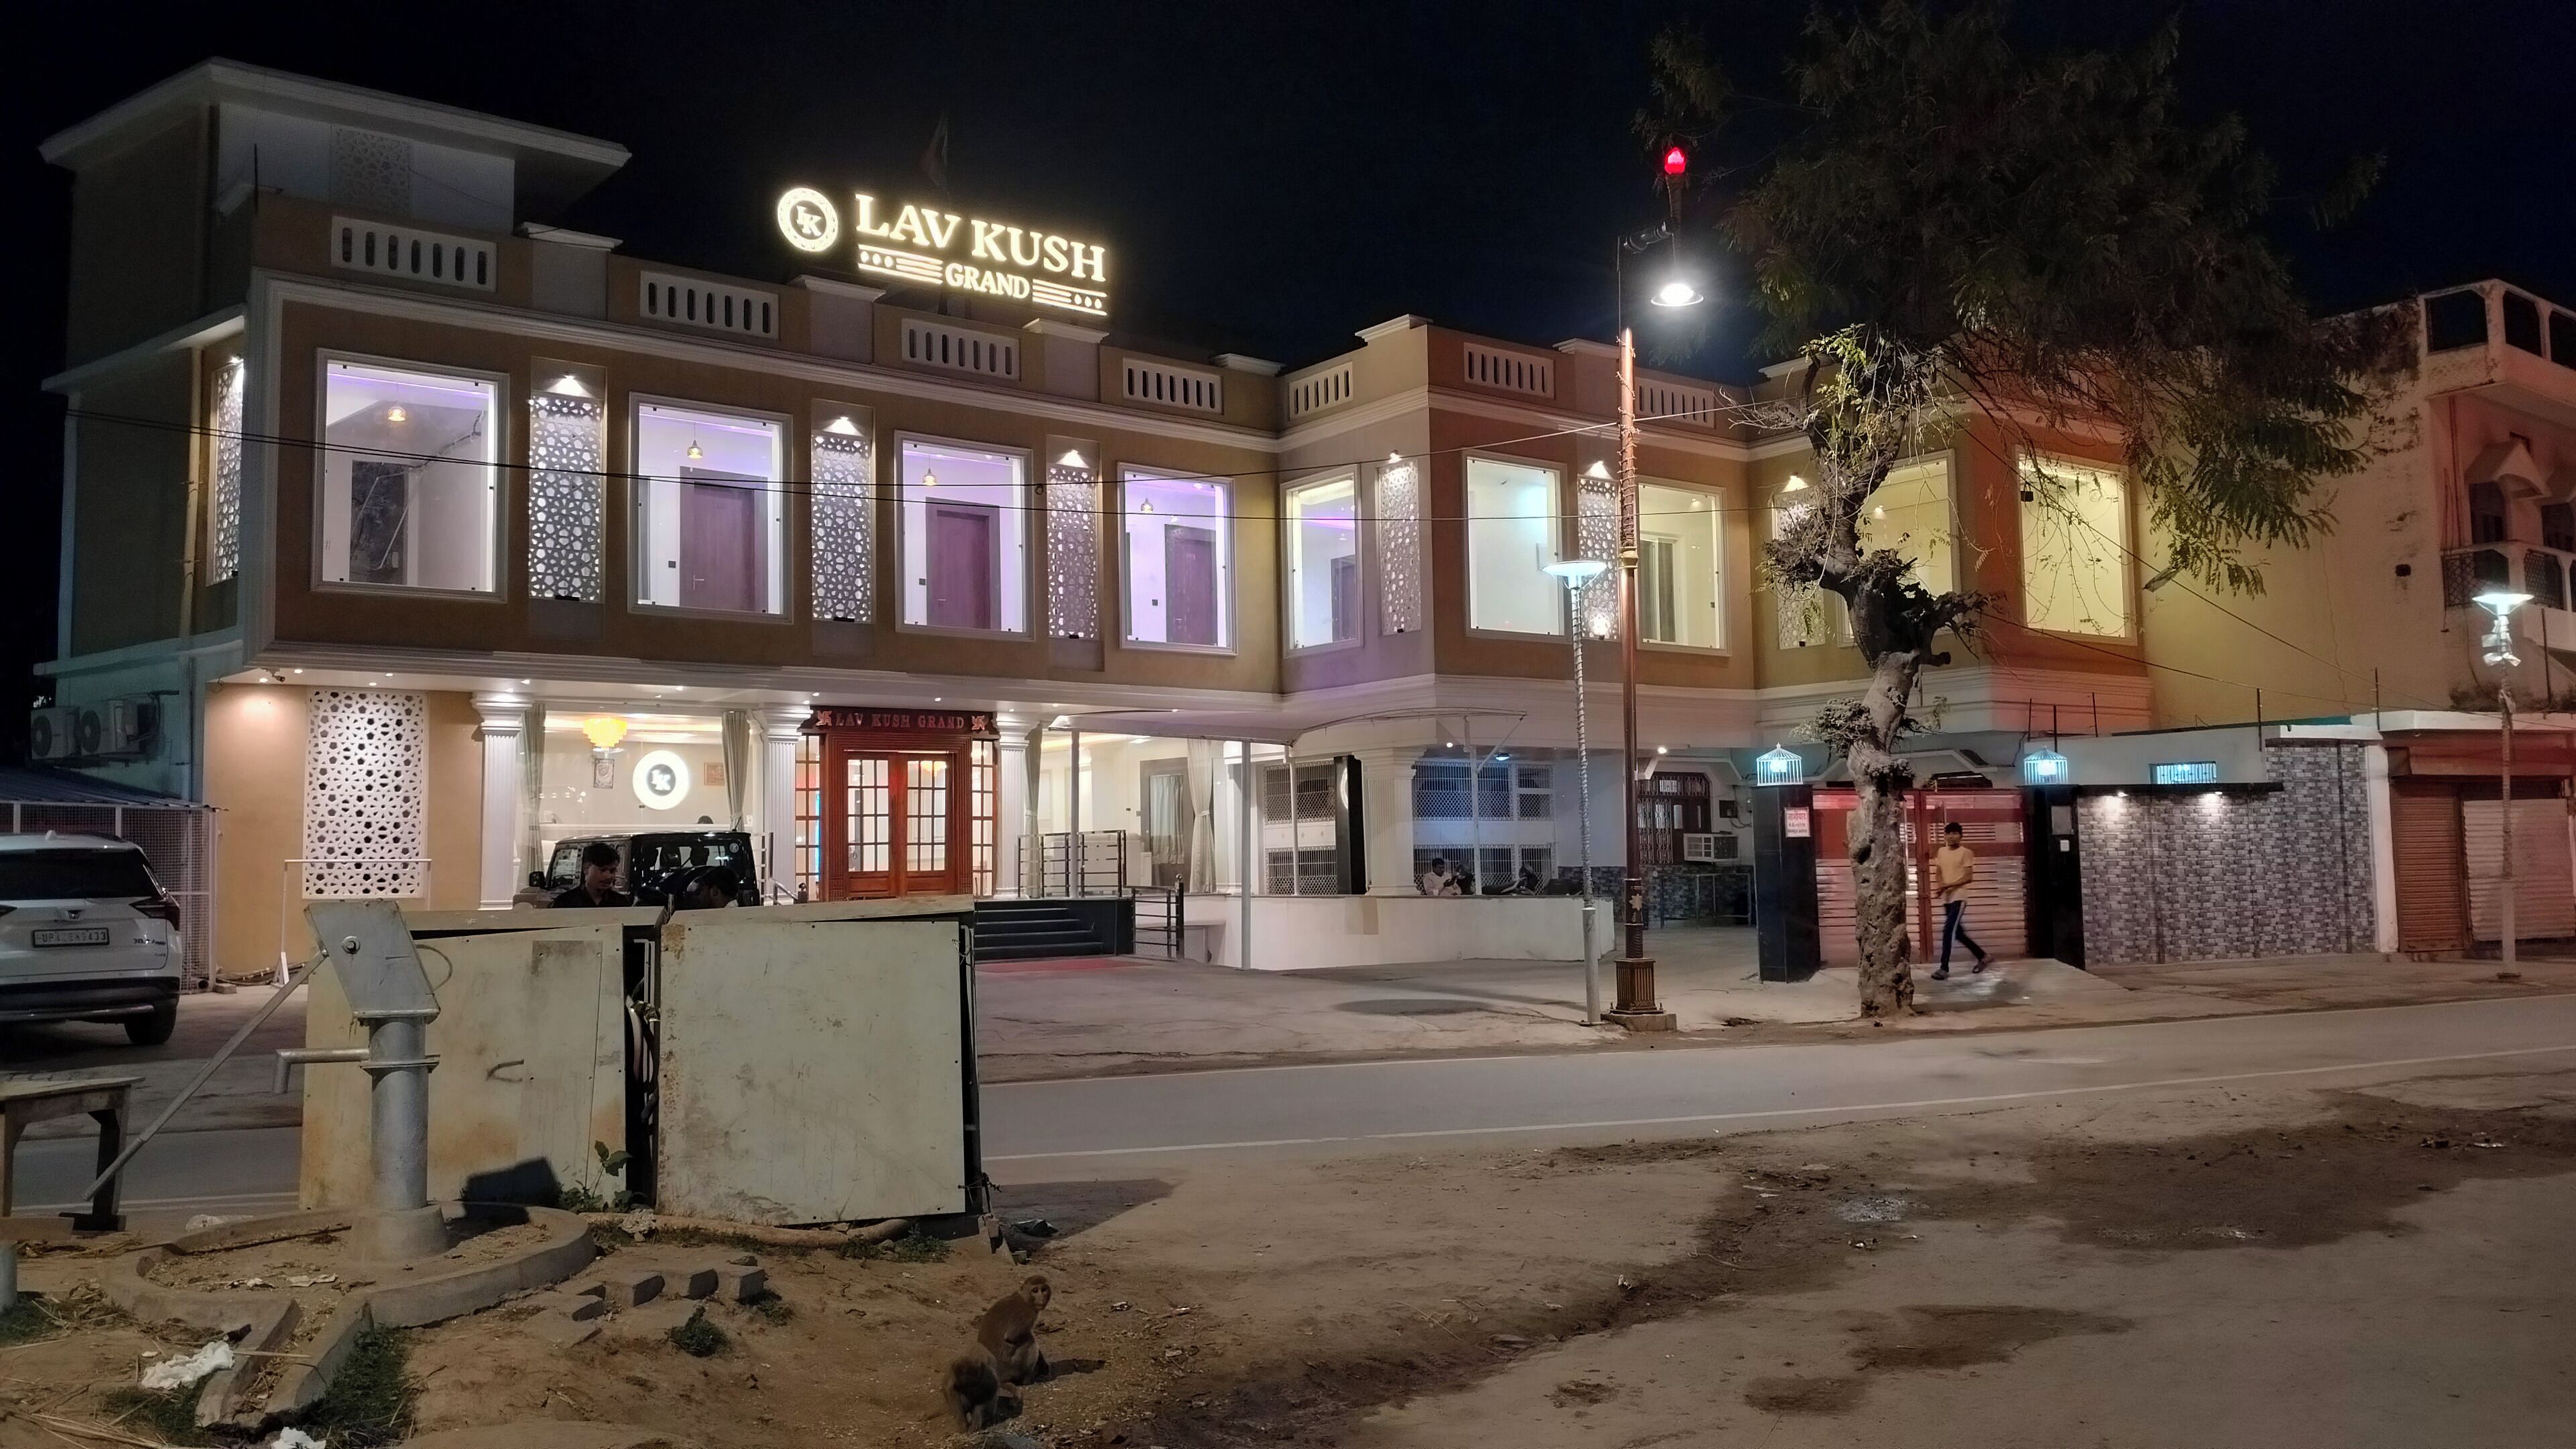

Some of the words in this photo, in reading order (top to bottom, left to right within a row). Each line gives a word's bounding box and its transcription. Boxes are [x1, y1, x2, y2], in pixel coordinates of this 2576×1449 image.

[855, 193, 961, 248] LAV
[971, 219, 1106, 282] KUSH
[945, 262, 1030, 299] GRAND
[835, 712, 864, 727] LAV
[871, 714, 911, 729] KUSH
[917, 715, 965, 729] GRAND
